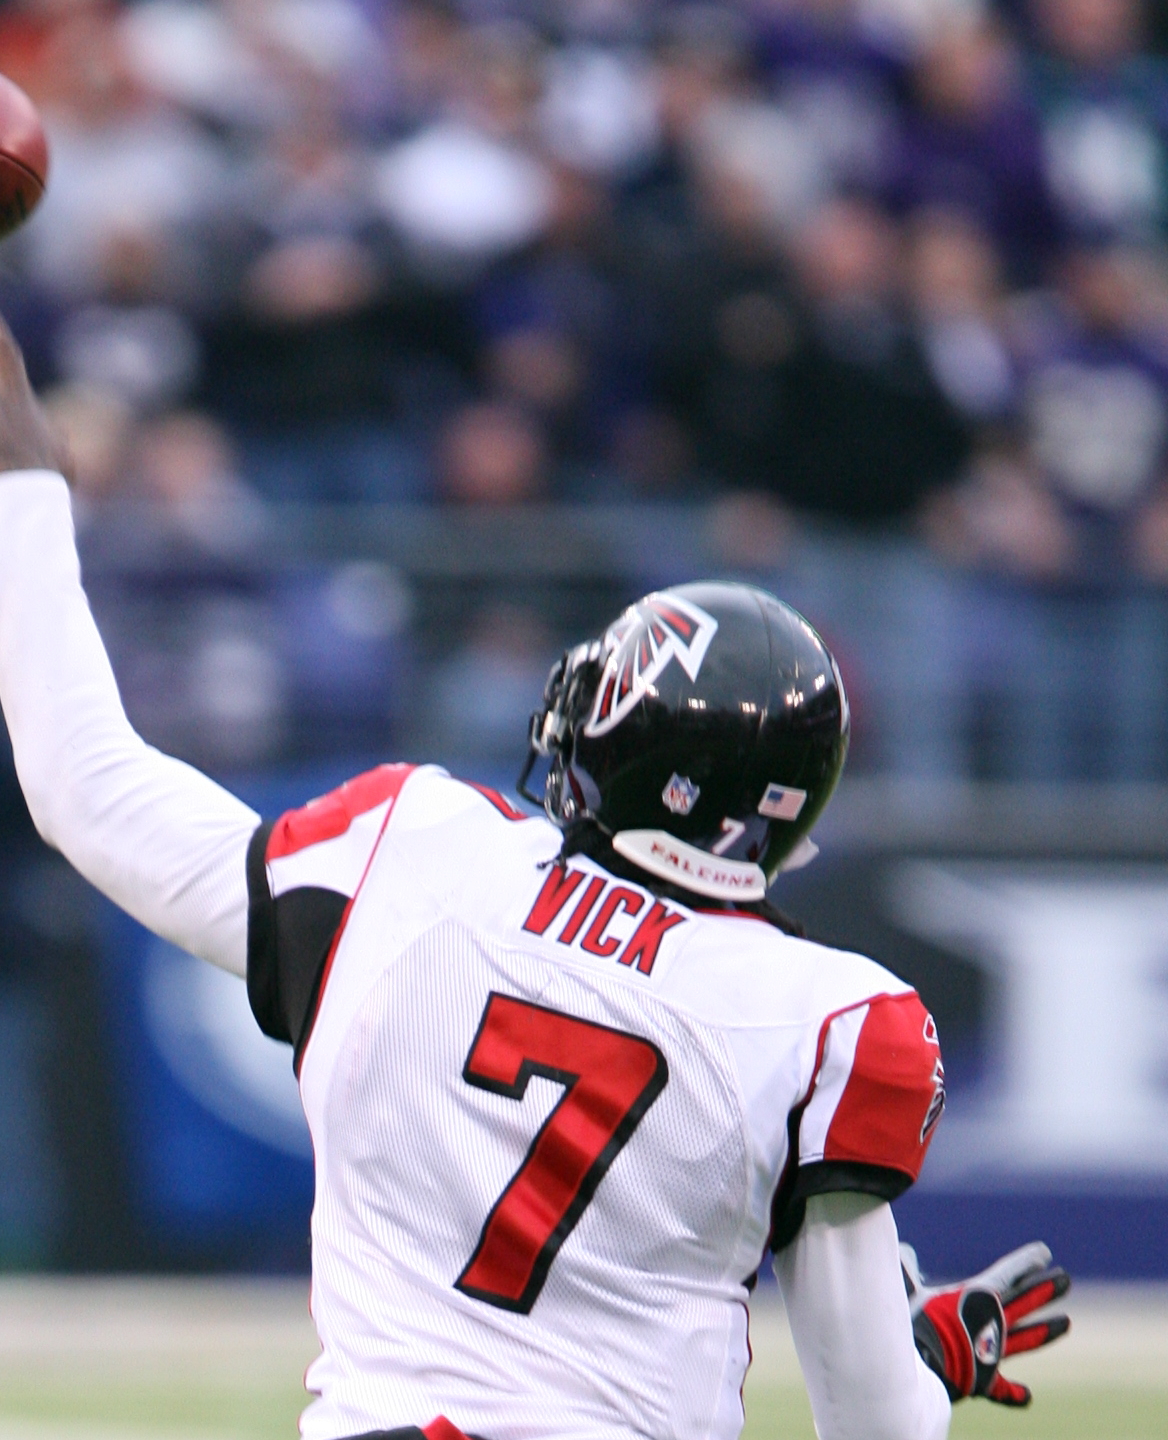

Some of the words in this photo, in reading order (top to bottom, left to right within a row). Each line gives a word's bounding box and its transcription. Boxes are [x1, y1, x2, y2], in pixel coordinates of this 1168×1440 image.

[650, 842, 755, 886] FALCONS
[712, 817, 746, 855] 7
[523, 864, 687, 976] VICK
[454, 991, 669, 1315] 7
